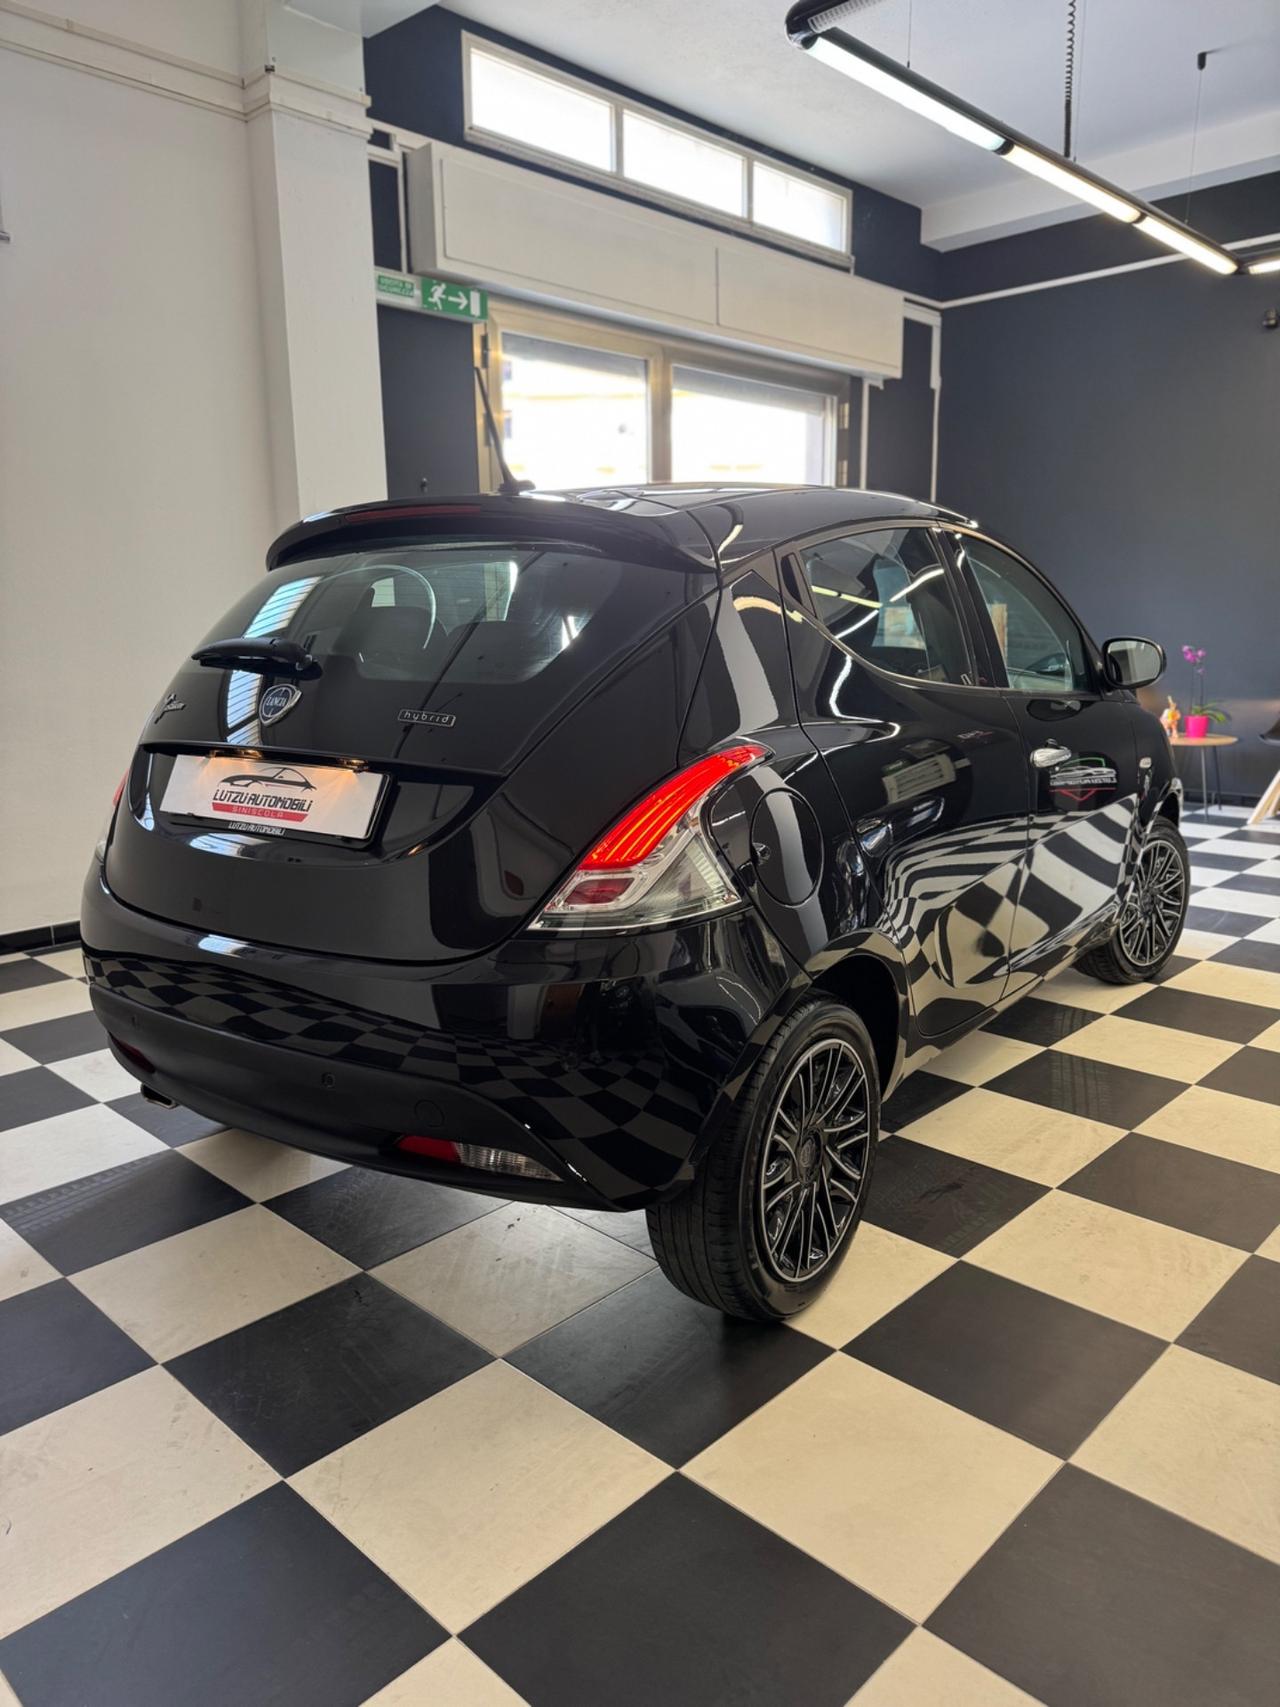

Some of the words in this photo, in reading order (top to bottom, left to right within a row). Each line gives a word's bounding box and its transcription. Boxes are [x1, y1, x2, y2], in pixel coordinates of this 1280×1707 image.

[403, 710, 449, 723] hybrid
[212, 788, 249, 805] LUTZU
[246, 793, 313, 812] AUTOMOBILI
[232, 806, 283, 819] SINISCOLA
[228, 821, 249, 831] LUTZU
